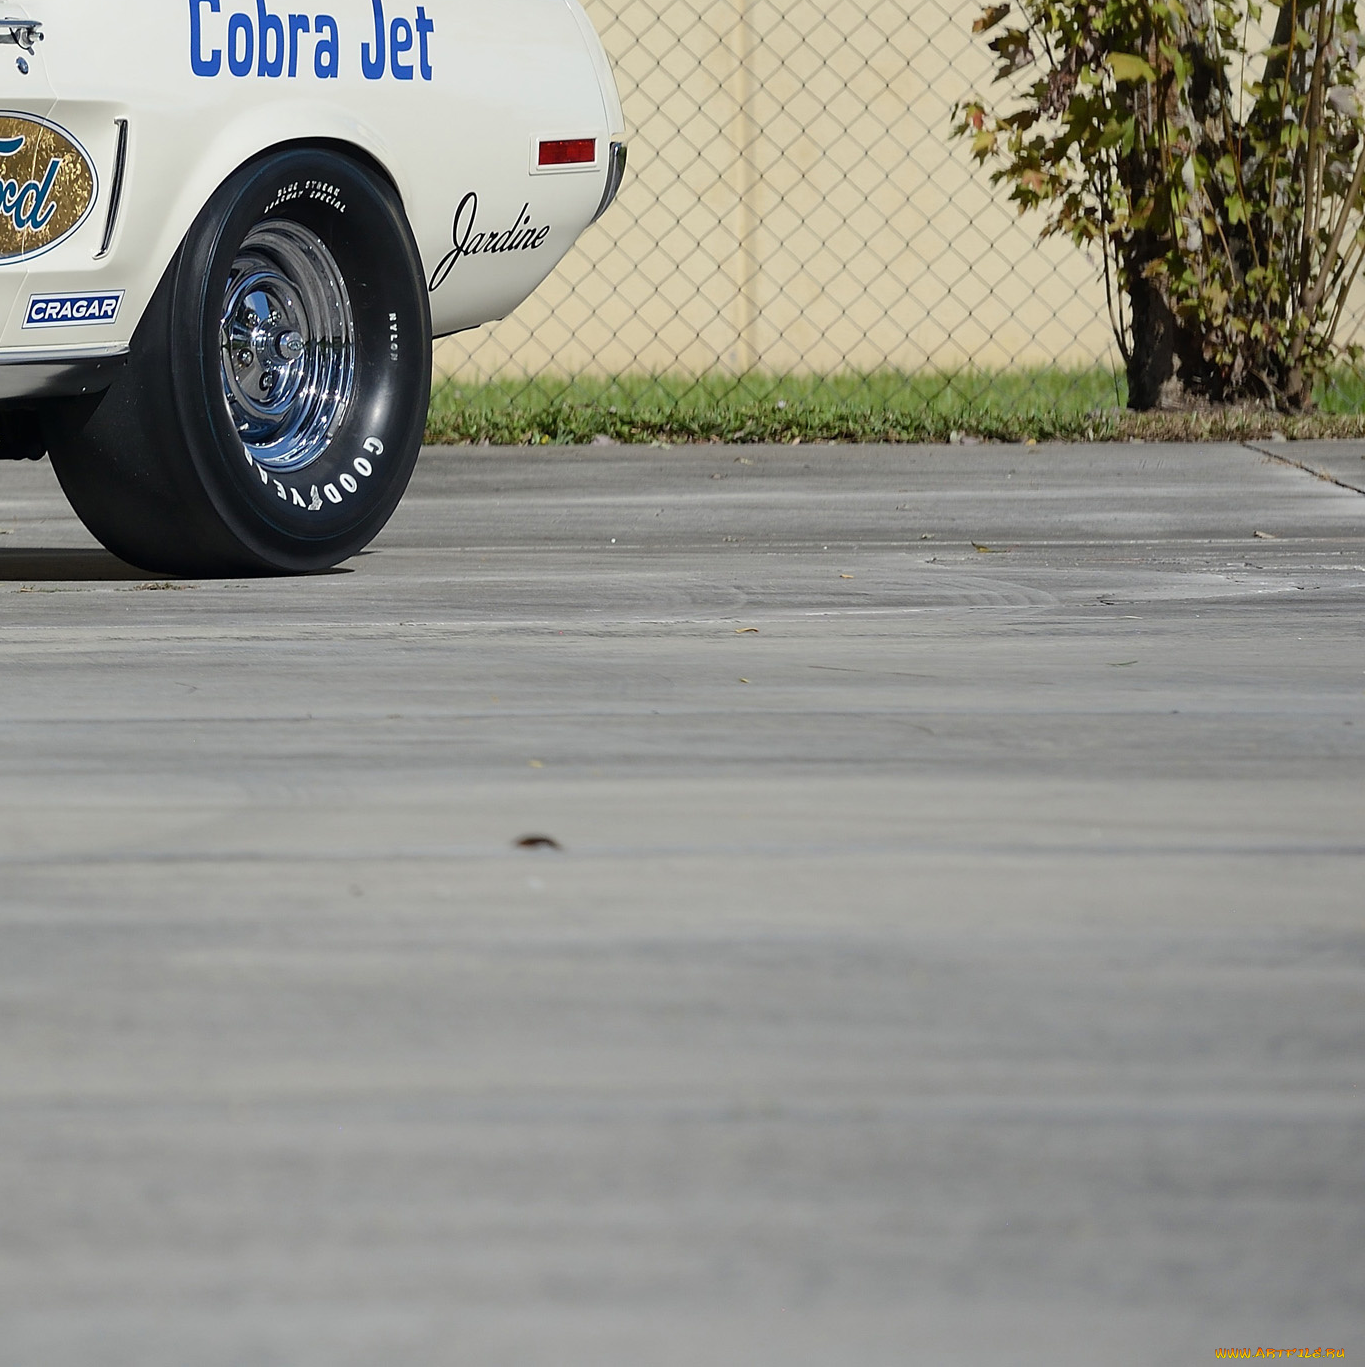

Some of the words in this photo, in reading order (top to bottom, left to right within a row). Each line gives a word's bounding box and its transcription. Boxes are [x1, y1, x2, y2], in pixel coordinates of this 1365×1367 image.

[277, 181, 299, 197] BLUE
[305, 180, 341, 197] STREAK
[309, 190, 346, 213] SPECIAL
[429, 190, 550, 293] Jardine
[29, 297, 118, 321] CRAGAR
[388, 312, 399, 362] NYLON
[243, 435, 385, 511] GOODYEAR
